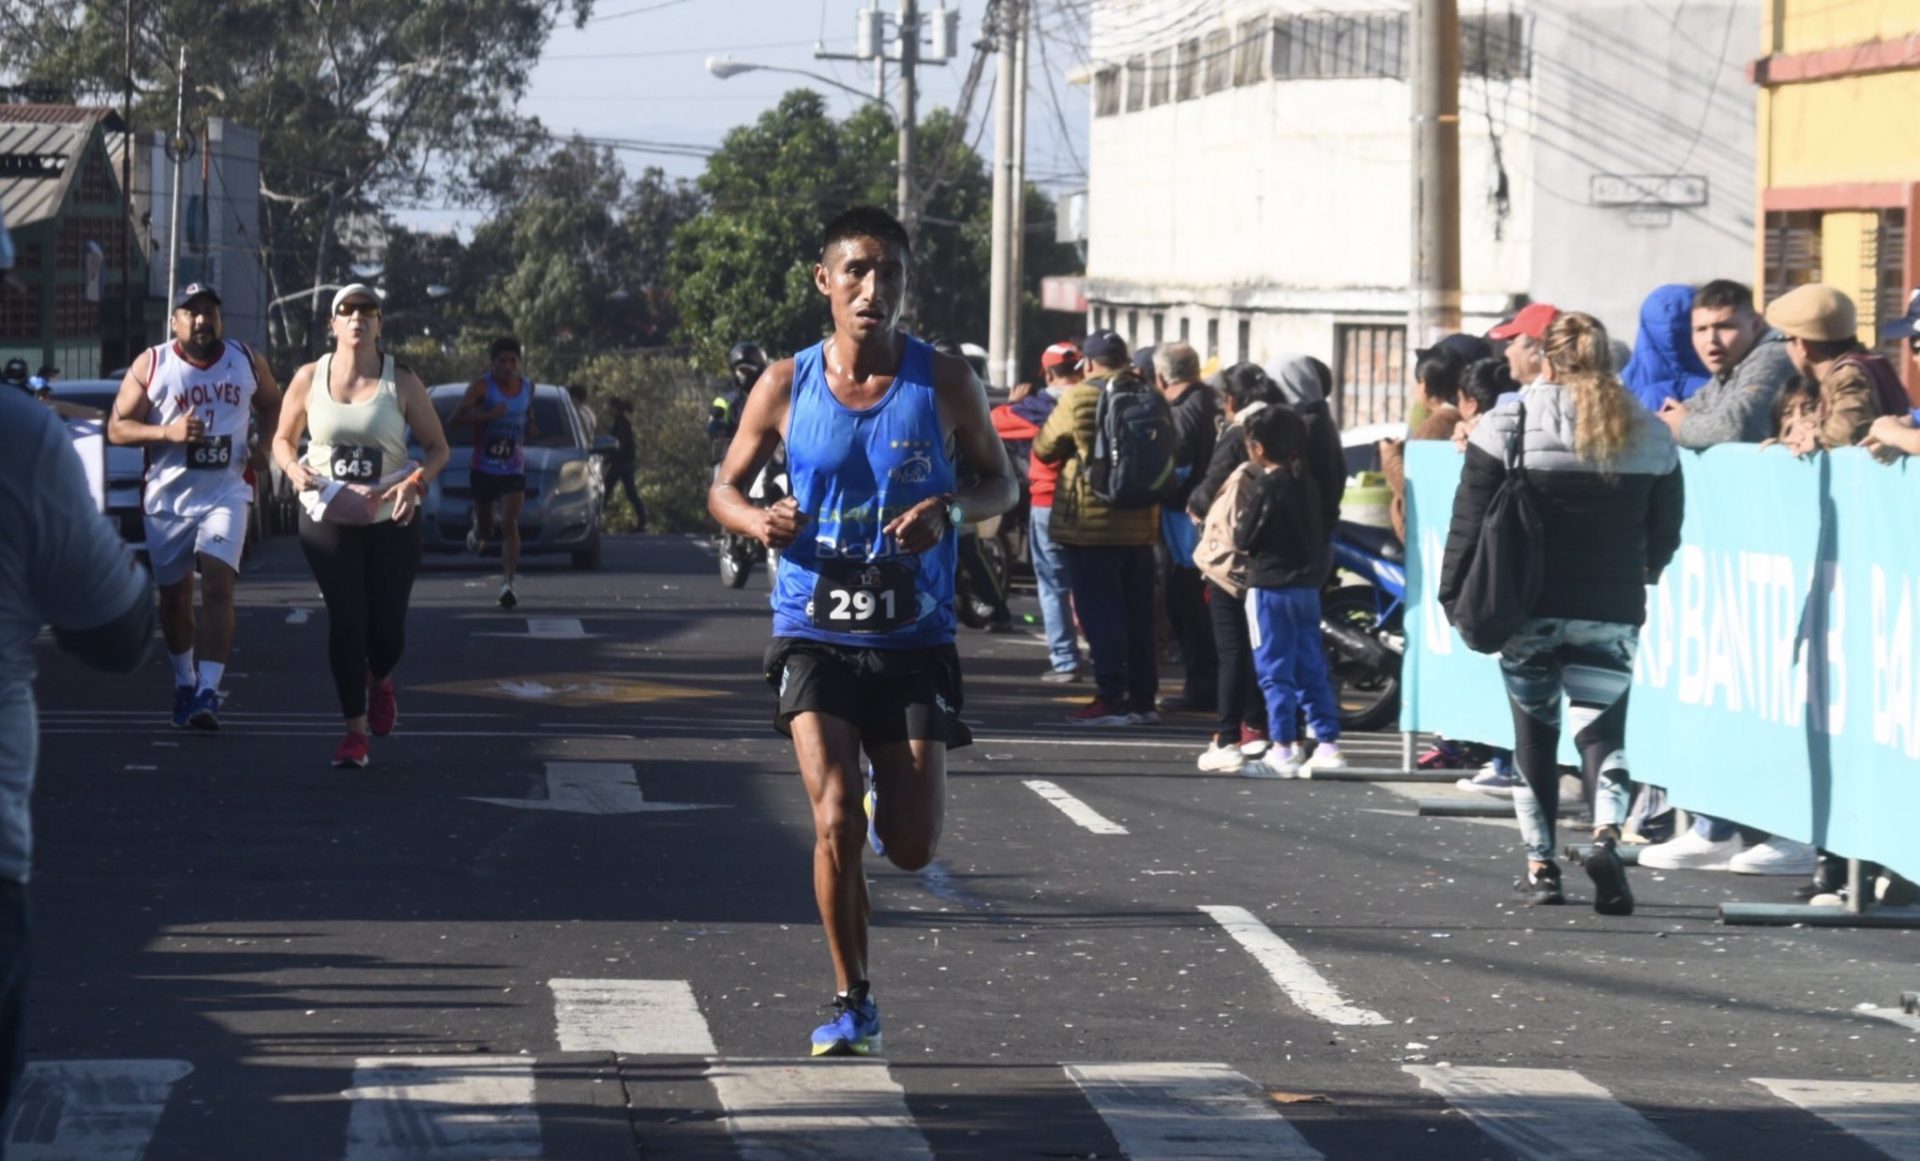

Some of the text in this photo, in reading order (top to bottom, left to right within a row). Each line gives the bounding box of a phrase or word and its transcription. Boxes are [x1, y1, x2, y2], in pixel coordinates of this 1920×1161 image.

[174, 382, 241, 413] WOLVES
[195, 447, 228, 463] 656
[334, 458, 372, 477] 643
[829, 589, 895, 620] 291
[1678, 544, 1847, 736] BANTRAB
